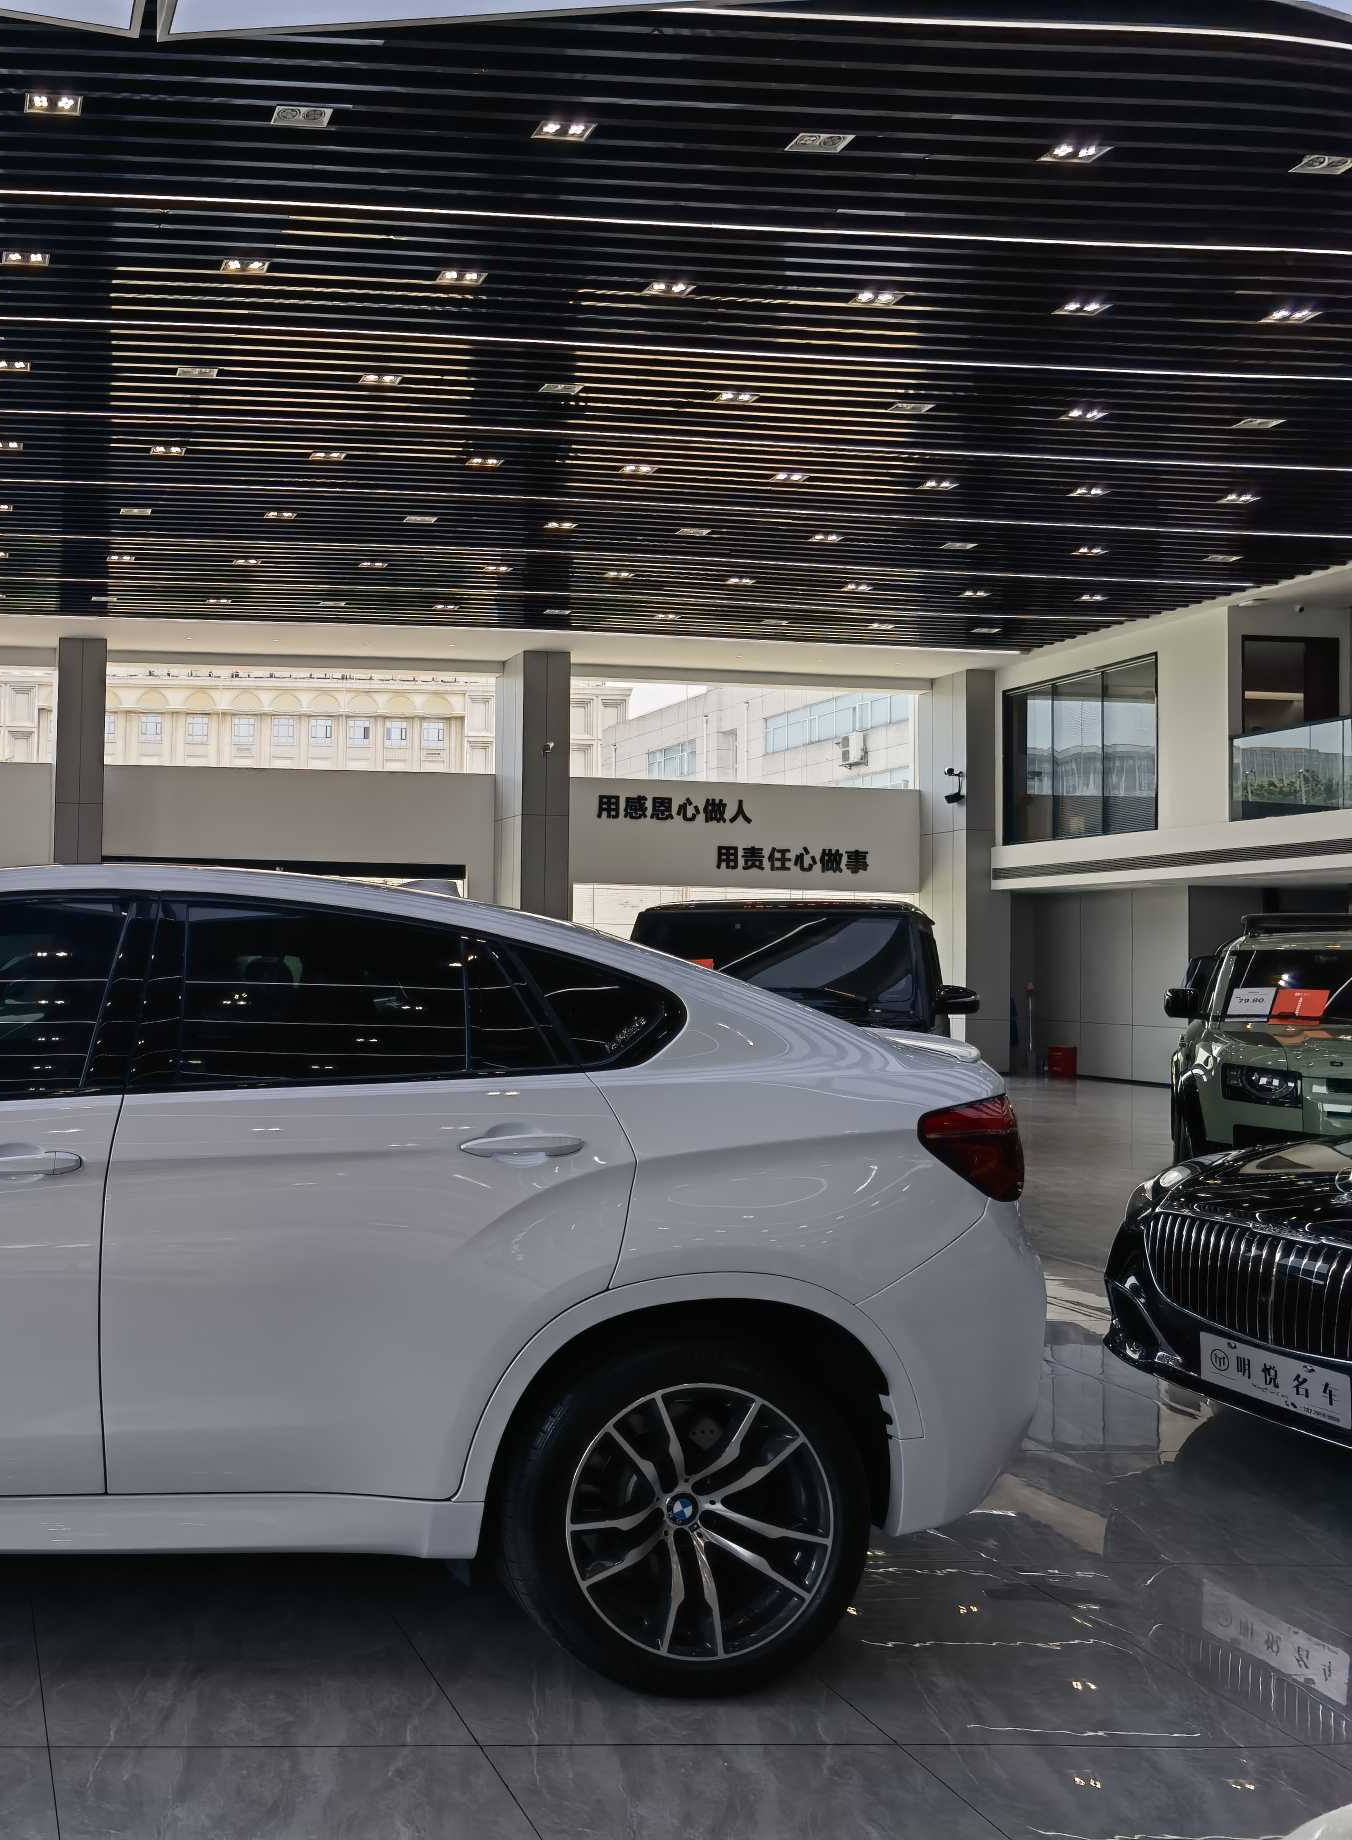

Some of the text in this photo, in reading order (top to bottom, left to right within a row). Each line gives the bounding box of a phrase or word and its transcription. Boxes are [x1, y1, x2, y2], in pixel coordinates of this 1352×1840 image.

[597, 794, 753, 824] 用感恩心做人
[715, 845, 870, 875] 用责任心做事
[1235, 1356, 1337, 1406] 明悦名车
